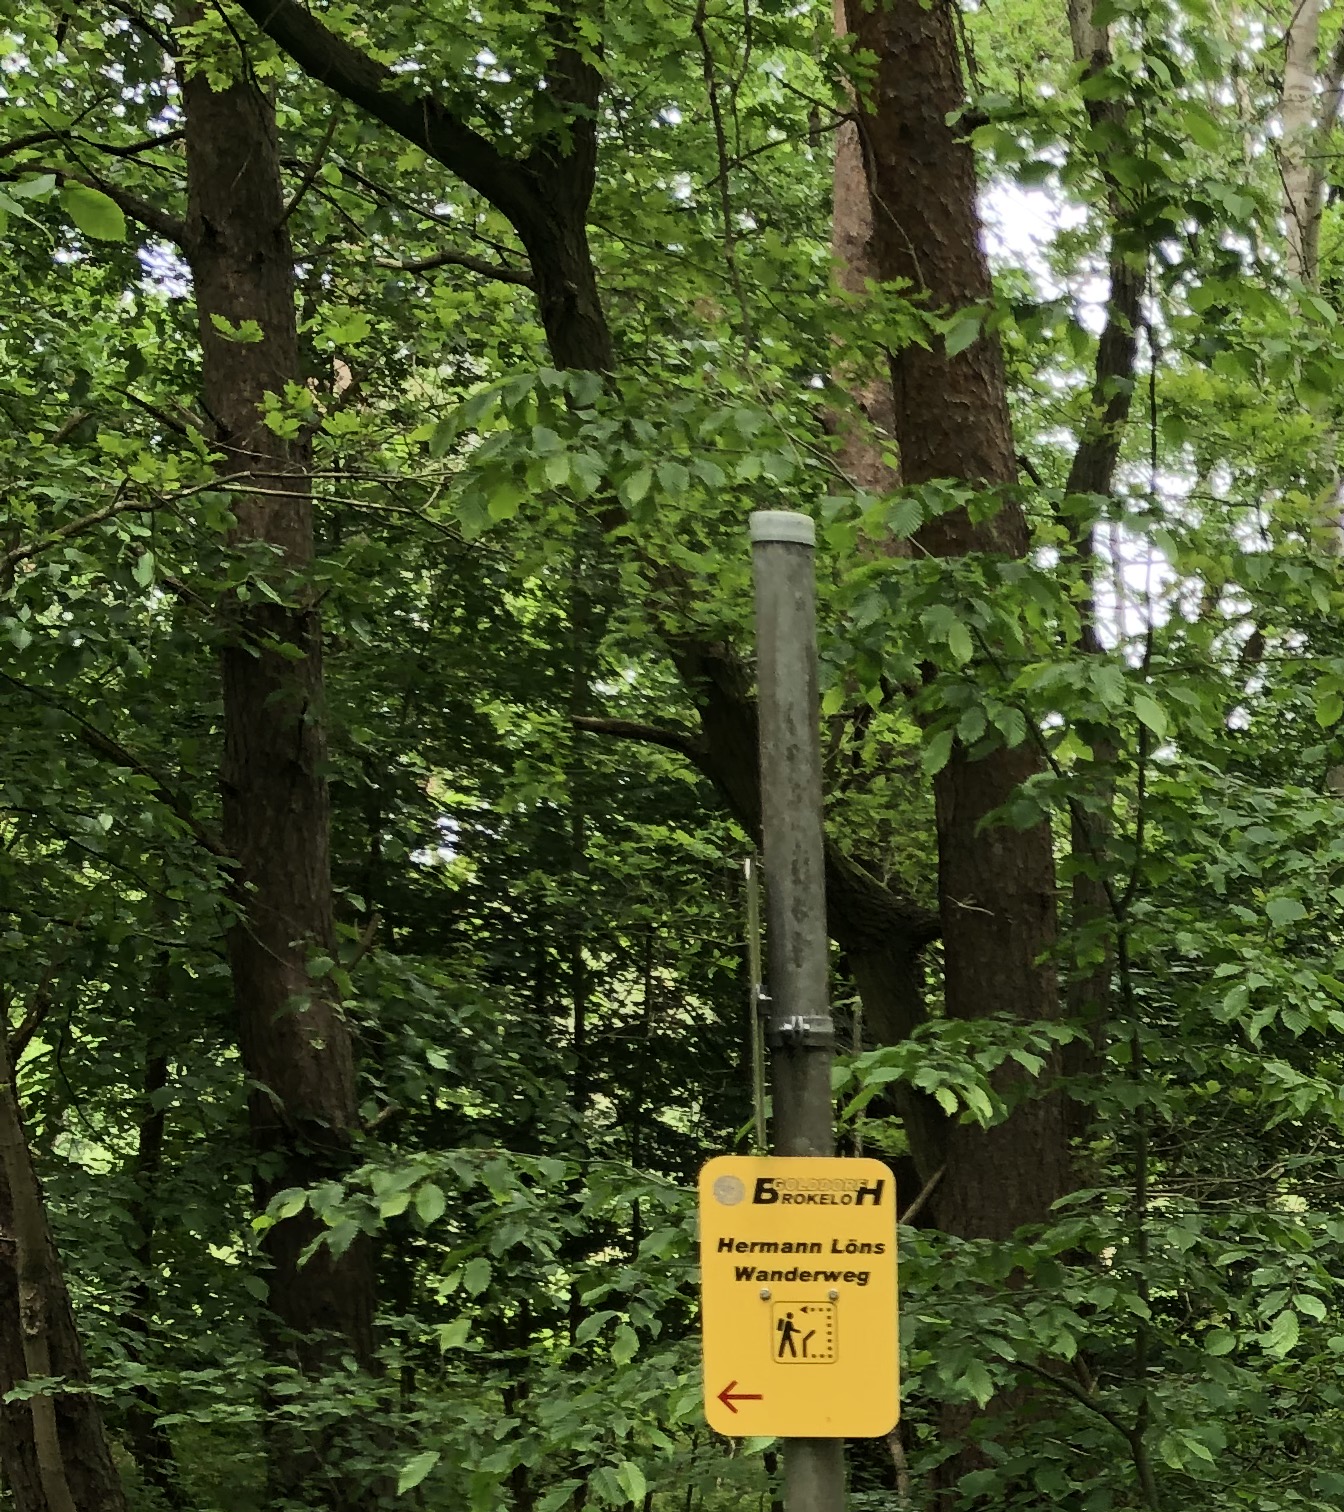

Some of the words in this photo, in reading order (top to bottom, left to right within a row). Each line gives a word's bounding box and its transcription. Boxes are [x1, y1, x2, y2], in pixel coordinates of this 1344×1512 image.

[752, 1177, 886, 1206] BROKELOH
[717, 1237, 823, 1254] Hermann
[830, 1238, 886, 1255] Löns
[734, 1265, 871, 1286] Wanderweg
